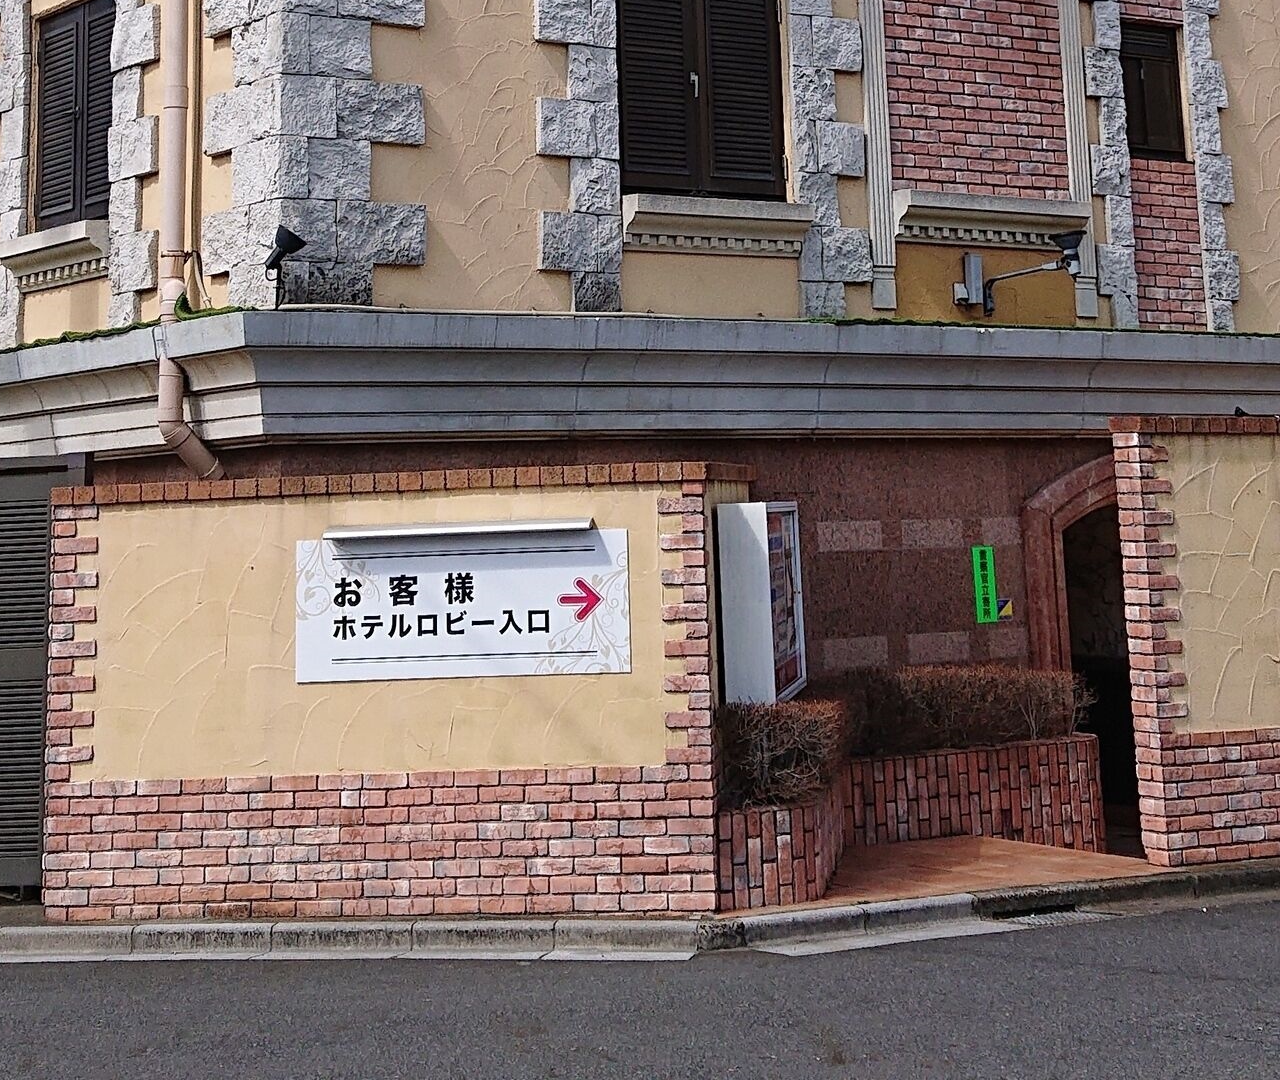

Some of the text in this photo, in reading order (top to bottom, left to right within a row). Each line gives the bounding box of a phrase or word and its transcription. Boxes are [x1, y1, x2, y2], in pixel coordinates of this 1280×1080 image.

[333, 572, 475, 607] お客様
[332, 609, 551, 640] ホテルロビー入口
